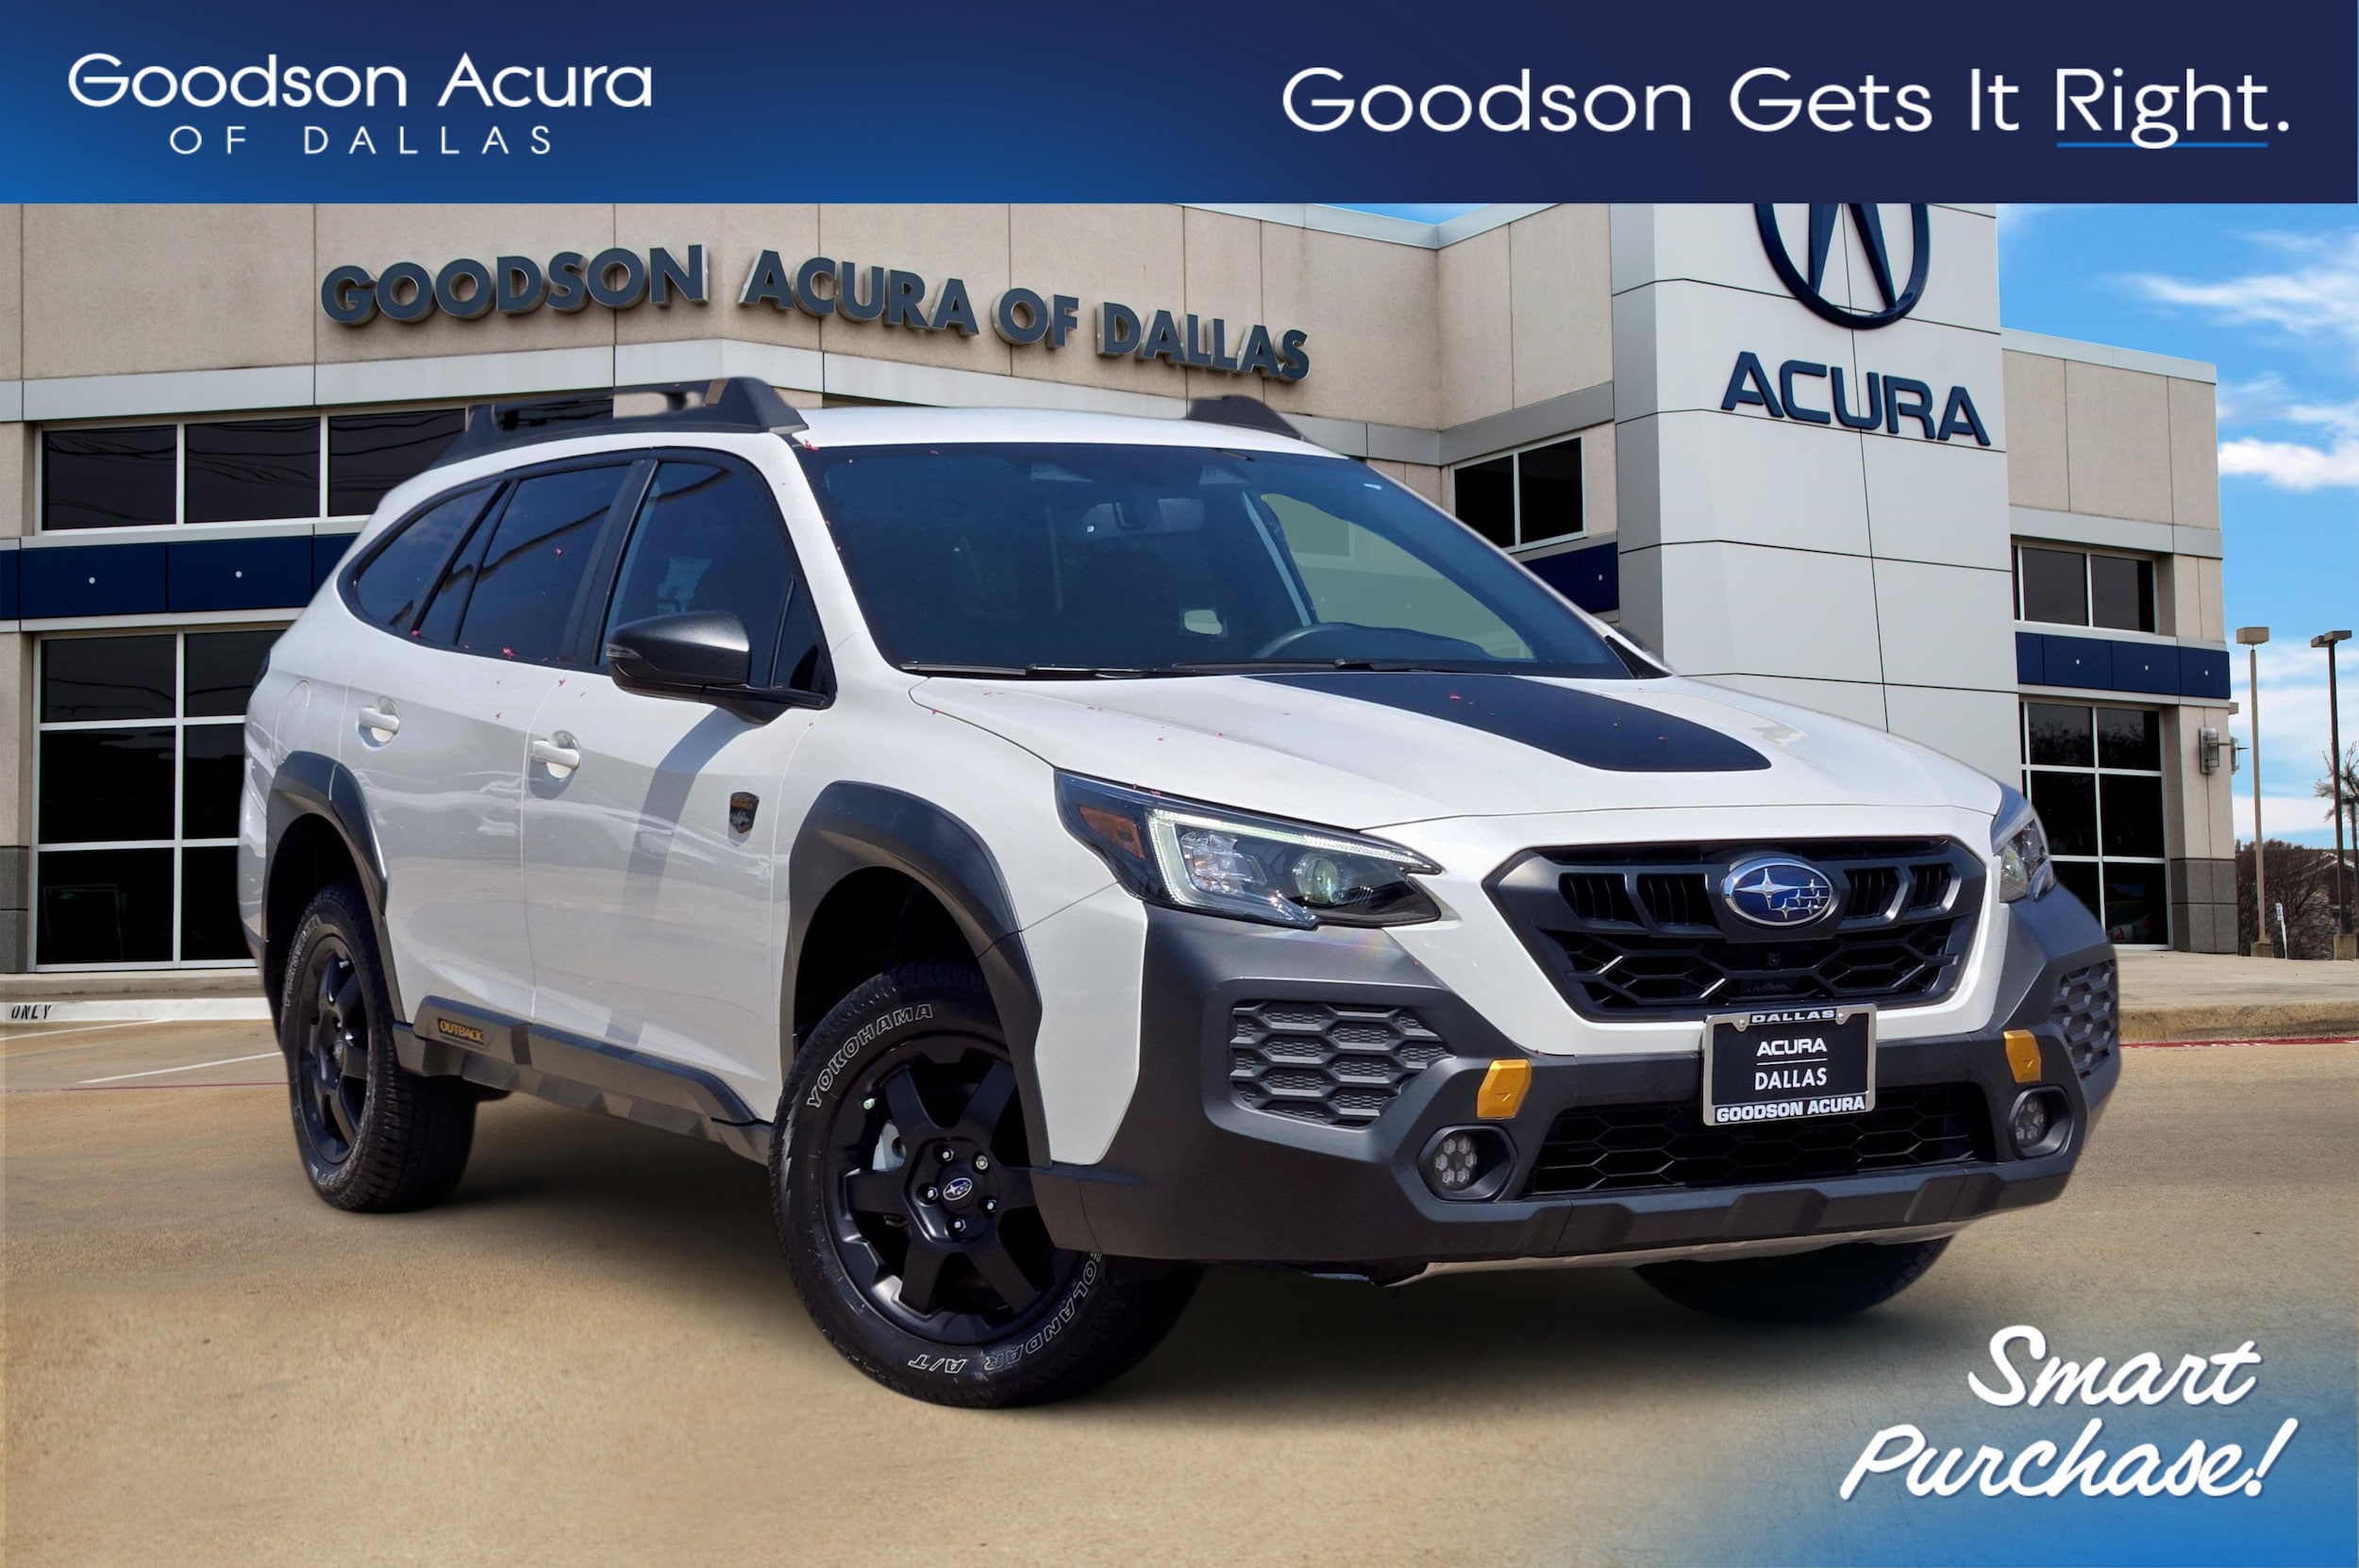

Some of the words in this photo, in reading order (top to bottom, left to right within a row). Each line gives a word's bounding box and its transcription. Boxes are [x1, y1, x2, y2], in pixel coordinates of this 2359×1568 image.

[320, 243, 710, 325] GOODSON
[737, 249, 979, 337] ACURA
[991, 287, 1079, 349] OF
[1096, 301, 1311, 381] DALLAS
[1720, 351, 1991, 446] ACURA
[10, 1004, 52, 1020] ONLY
[1751, 1009, 1836, 1024] DALLAS
[439, 1020, 483, 1042] OUTBACK
[807, 1003, 934, 1109] YOKOHAMA
[1756, 1037, 1828, 1058] ACURA
[1754, 1066, 1828, 1092] DALLAS
[1715, 1100, 1803, 1124] GOODSON
[1806, 1094, 1865, 1115] ACURA
[907, 1353, 967, 1374] A/T
